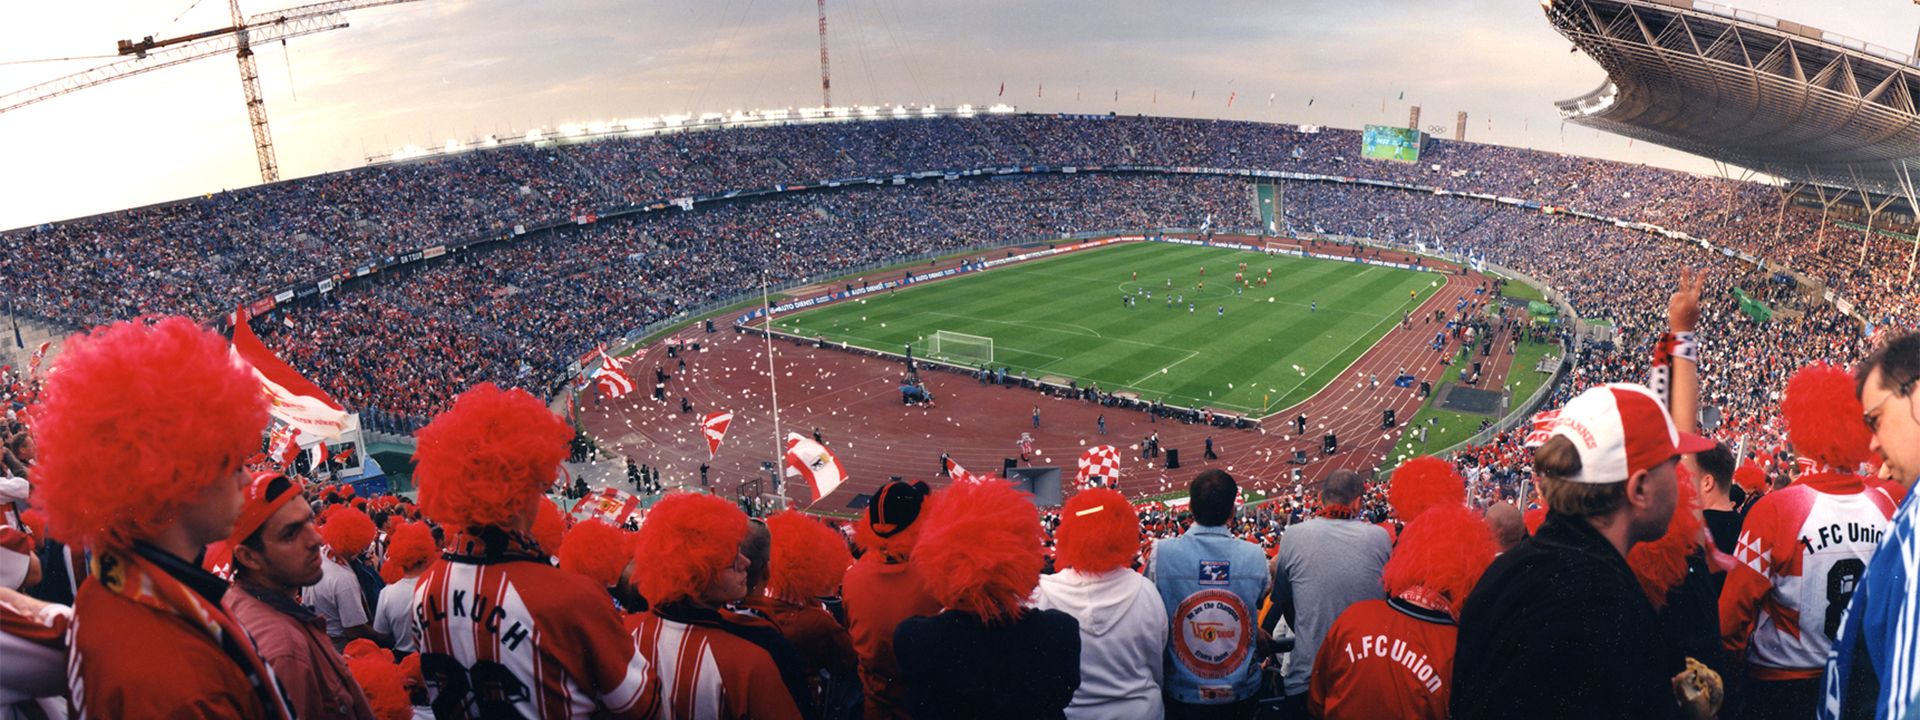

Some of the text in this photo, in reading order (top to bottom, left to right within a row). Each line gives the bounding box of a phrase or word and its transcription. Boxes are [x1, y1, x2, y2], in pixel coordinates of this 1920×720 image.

[915, 274, 928, 282] AUTO
[851, 287, 866, 296] AUTO
[866, 282, 884, 293] DIENST
[777, 303, 794, 312] AUTO
[795, 299, 815, 309] DIENST
[1801, 522, 1885, 555] 1.FC Unio
[1204, 601, 1215, 610] the
[1345, 634, 1443, 694] 1.FC Union
